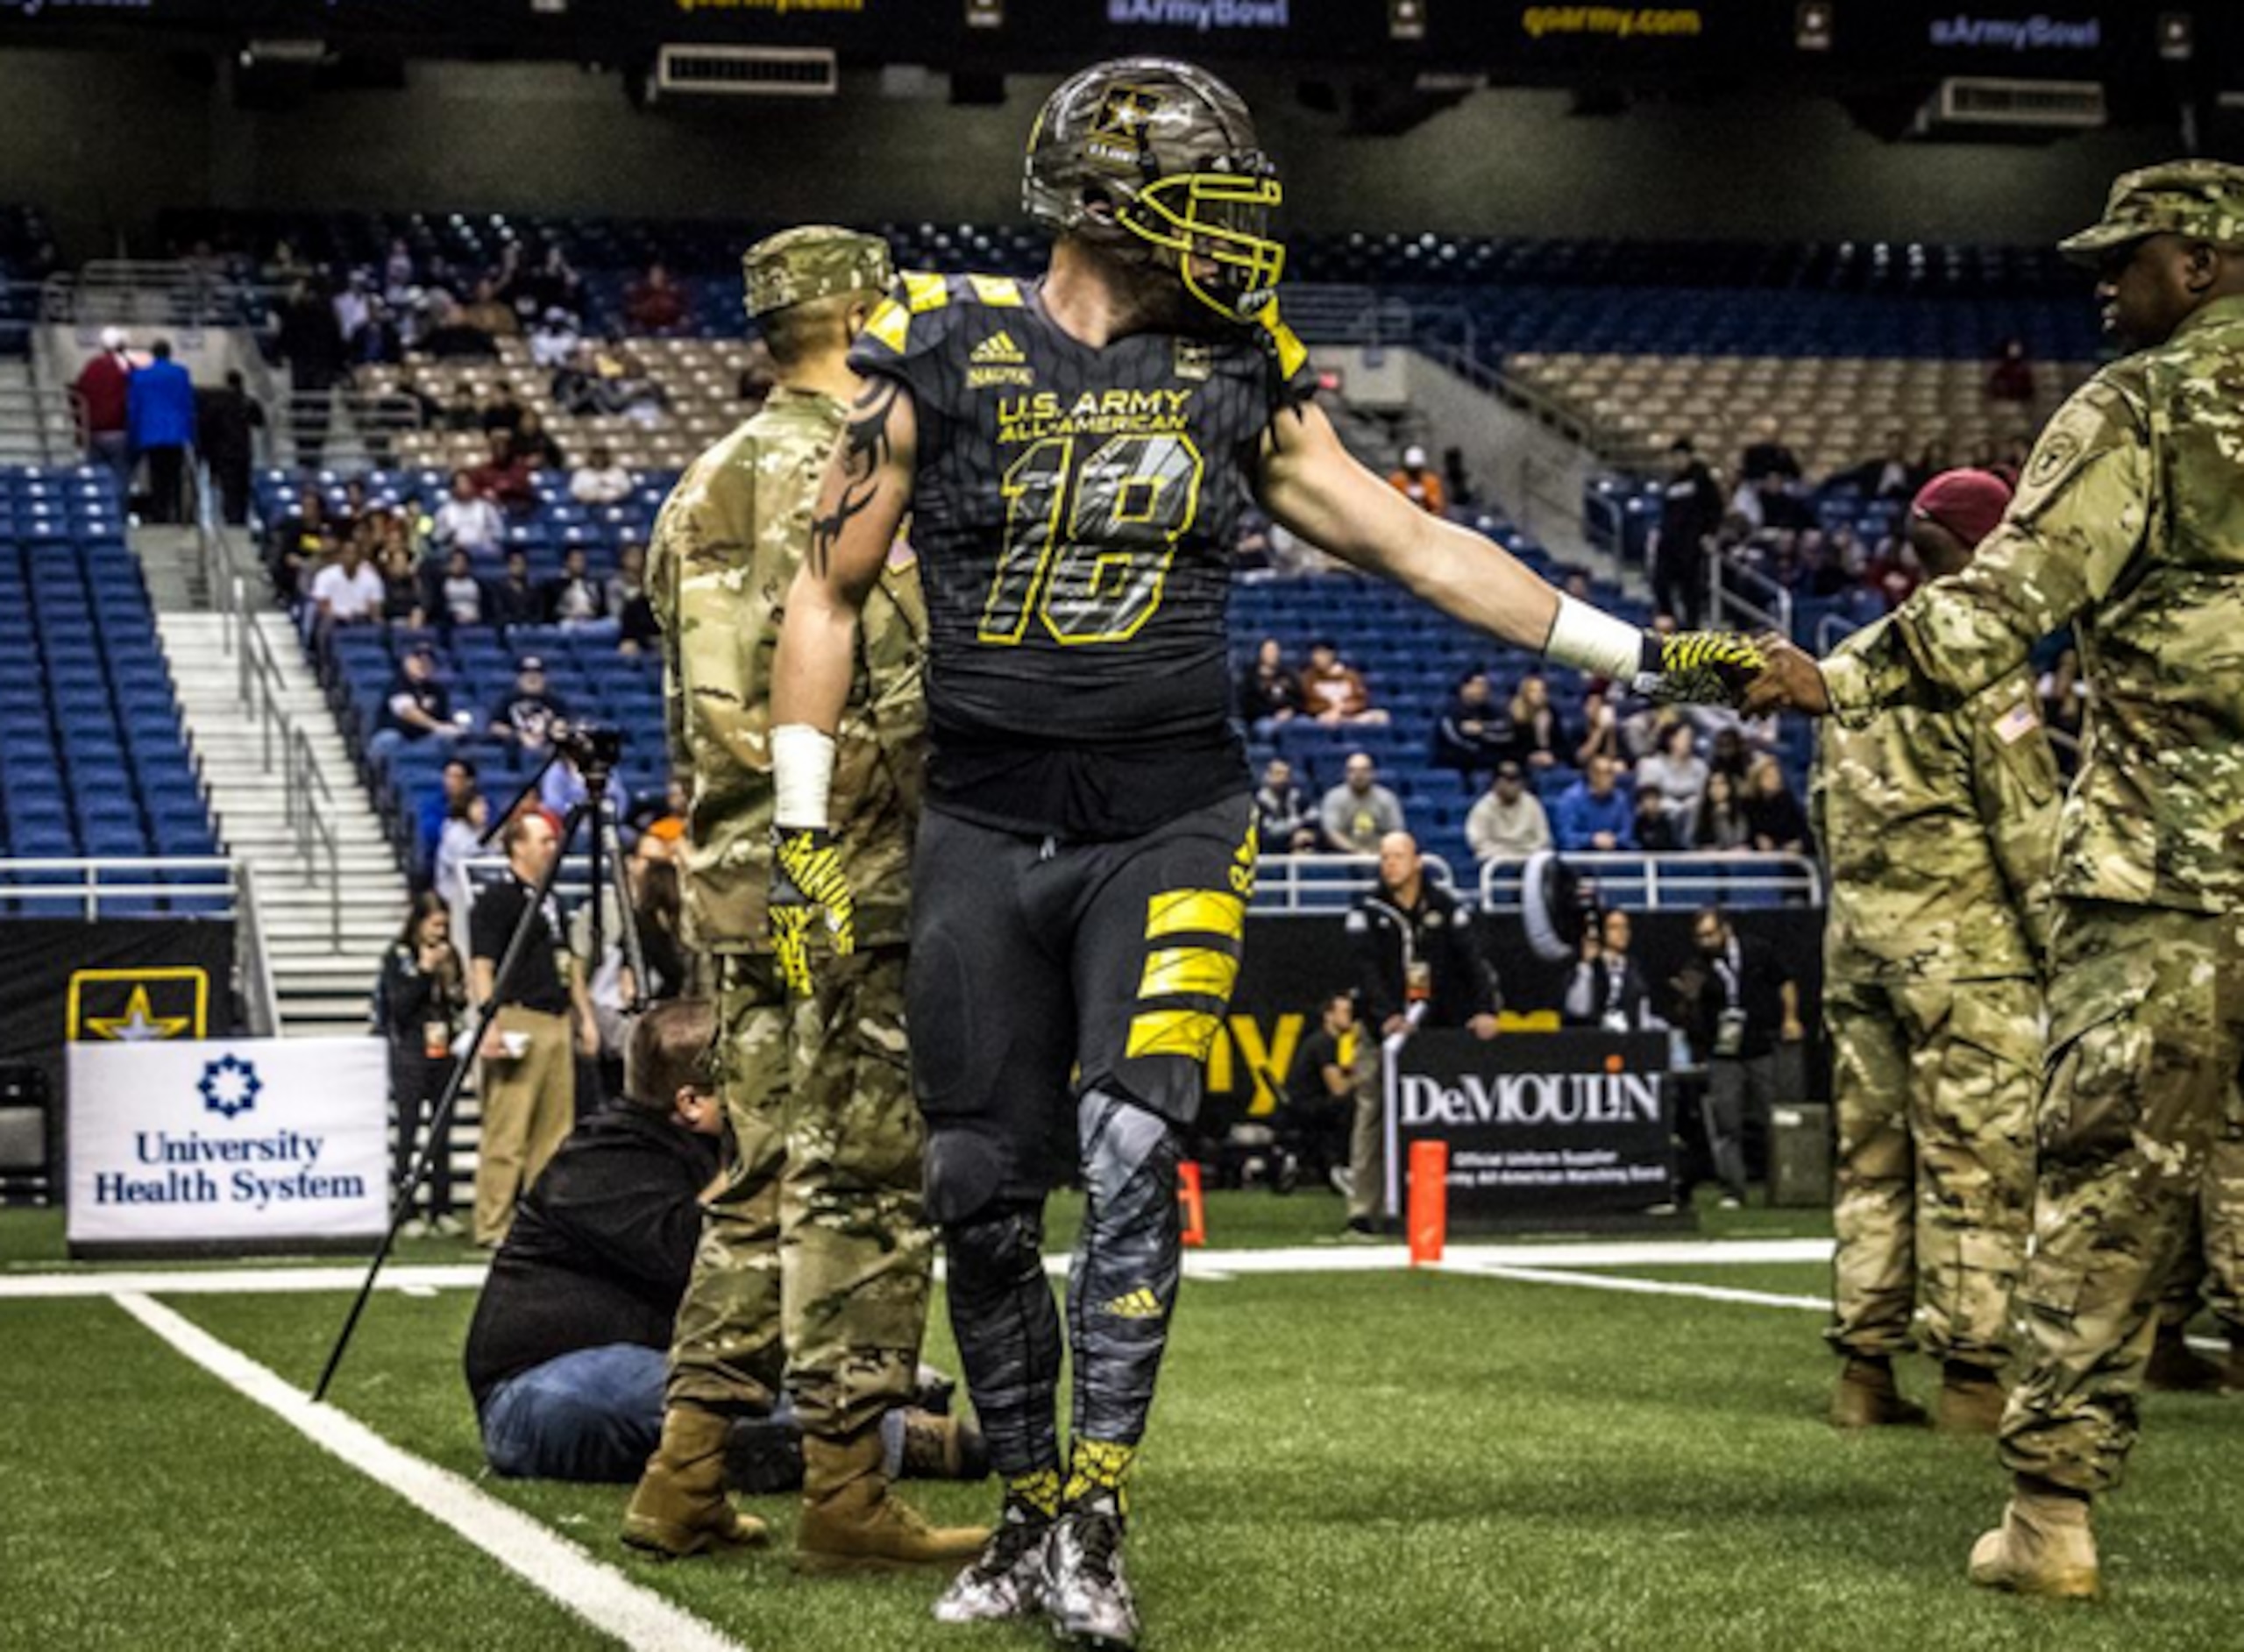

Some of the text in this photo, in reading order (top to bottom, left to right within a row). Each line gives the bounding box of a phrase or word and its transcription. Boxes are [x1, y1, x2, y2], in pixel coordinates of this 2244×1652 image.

[1070, 388, 1192, 416] ARMY
[977, 430, 1204, 647] 18
[135, 1130, 323, 1170] University
[95, 1168, 366, 1210] Health System
